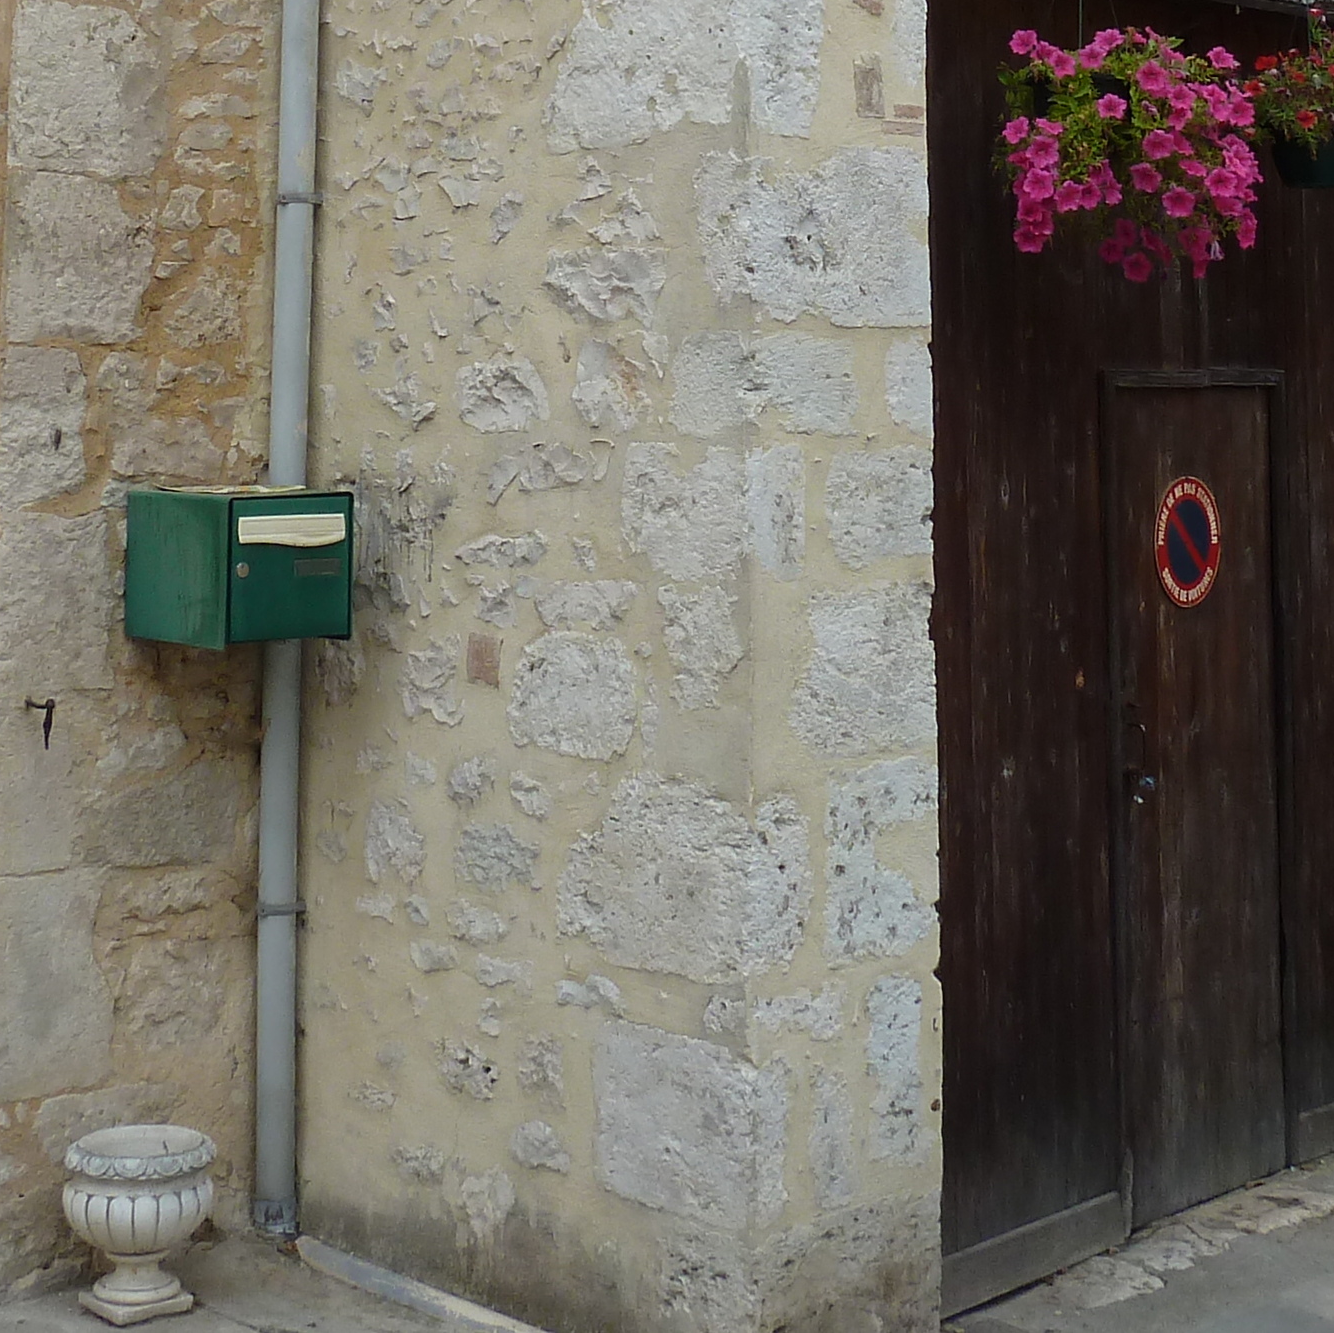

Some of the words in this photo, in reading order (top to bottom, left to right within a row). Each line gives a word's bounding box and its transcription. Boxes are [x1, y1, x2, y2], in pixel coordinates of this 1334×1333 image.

[1166, 493, 1175, 508] DE
[1174, 484, 1183, 499] NE
[1183, 482, 1196, 495] PAS
[1162, 567, 1180, 599] SORTIE
[1179, 589, 1187, 602] DE
